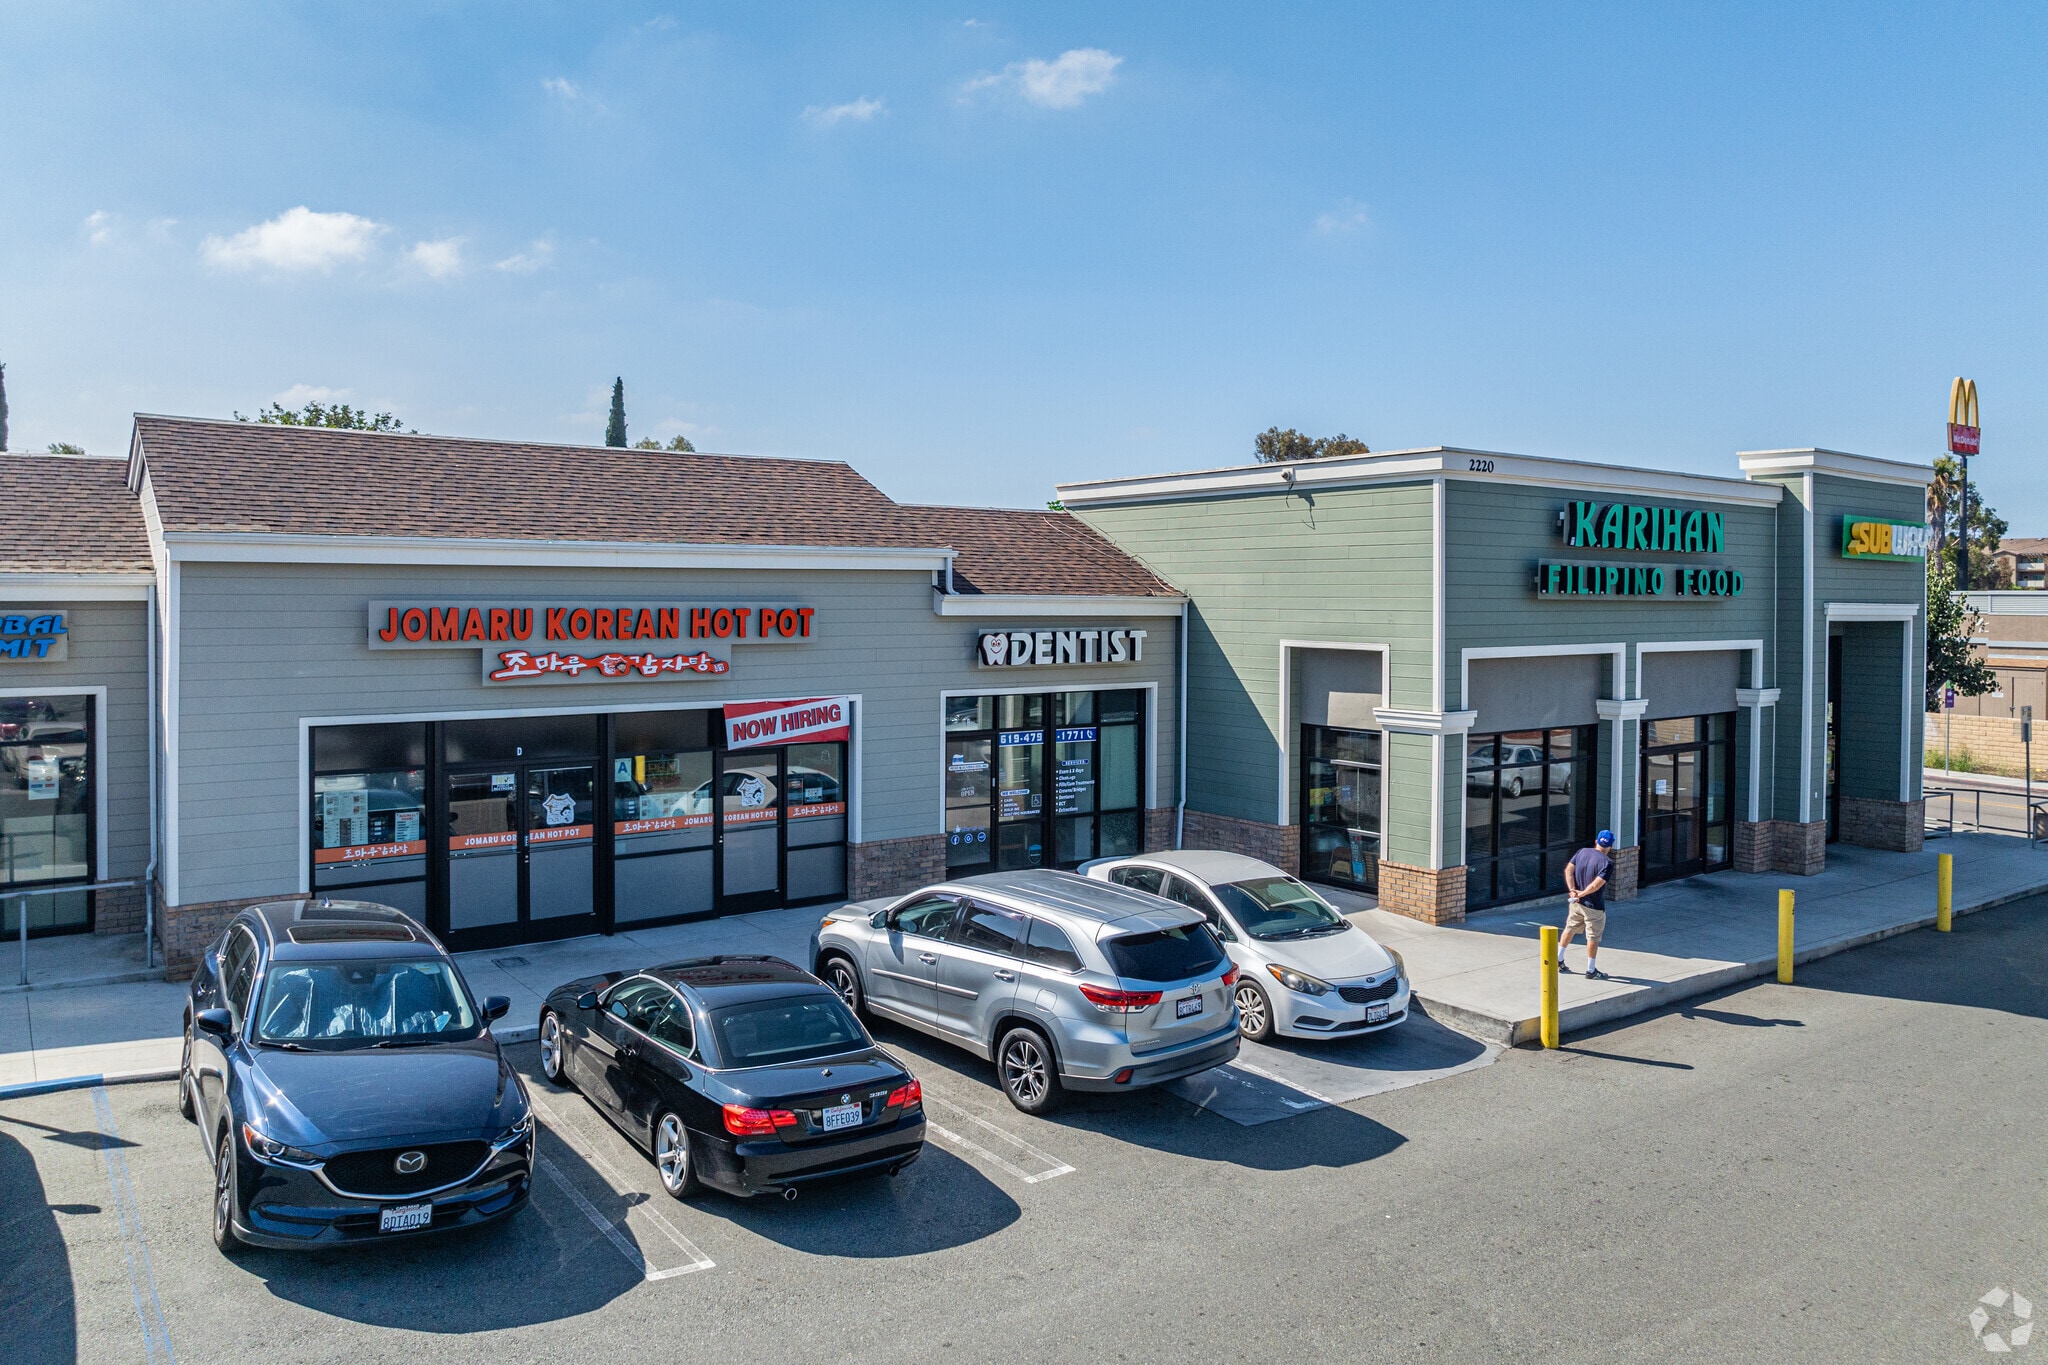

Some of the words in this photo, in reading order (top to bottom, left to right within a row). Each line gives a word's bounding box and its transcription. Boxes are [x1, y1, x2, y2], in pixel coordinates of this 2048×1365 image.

[1469, 459, 1494, 473] 2220
[1568, 501, 1724, 553] KARIHAN
[1847, 522, 1934, 557] SUBWAY
[1541, 564, 1664, 595] FILIPINO
[1676, 569, 1743, 596] FOOD
[0, 615, 68, 636] BAL
[379, 607, 533, 642] JOMARU
[546, 607, 679, 640] KOREAN
[690, 607, 750, 638] HOT
[759, 607, 814, 637] POT
[1010, 630, 1148, 666] DENTIST
[495, 652, 587, 678] 조마루
[630, 653, 712, 675] 감자탕
[732, 716, 777, 742] NOW
[780, 704, 841, 732] HIRING
[516, 747, 522, 756] D
[617, 761, 628, 773] A
[960, 789, 975, 797] OPEN
[684, 815, 713, 825] JOMARU
[723, 811, 749, 821] KOREAN
[751, 811, 763, 819] HOT
[765, 809, 777, 817] POT
[465, 836, 499, 846] JOMARU
[548, 830, 562, 839] HOT
[565, 828, 580, 837] POT
[826, 1110, 860, 1127] 8FFE039
[383, 1212, 430, 1229] 8DTA019
